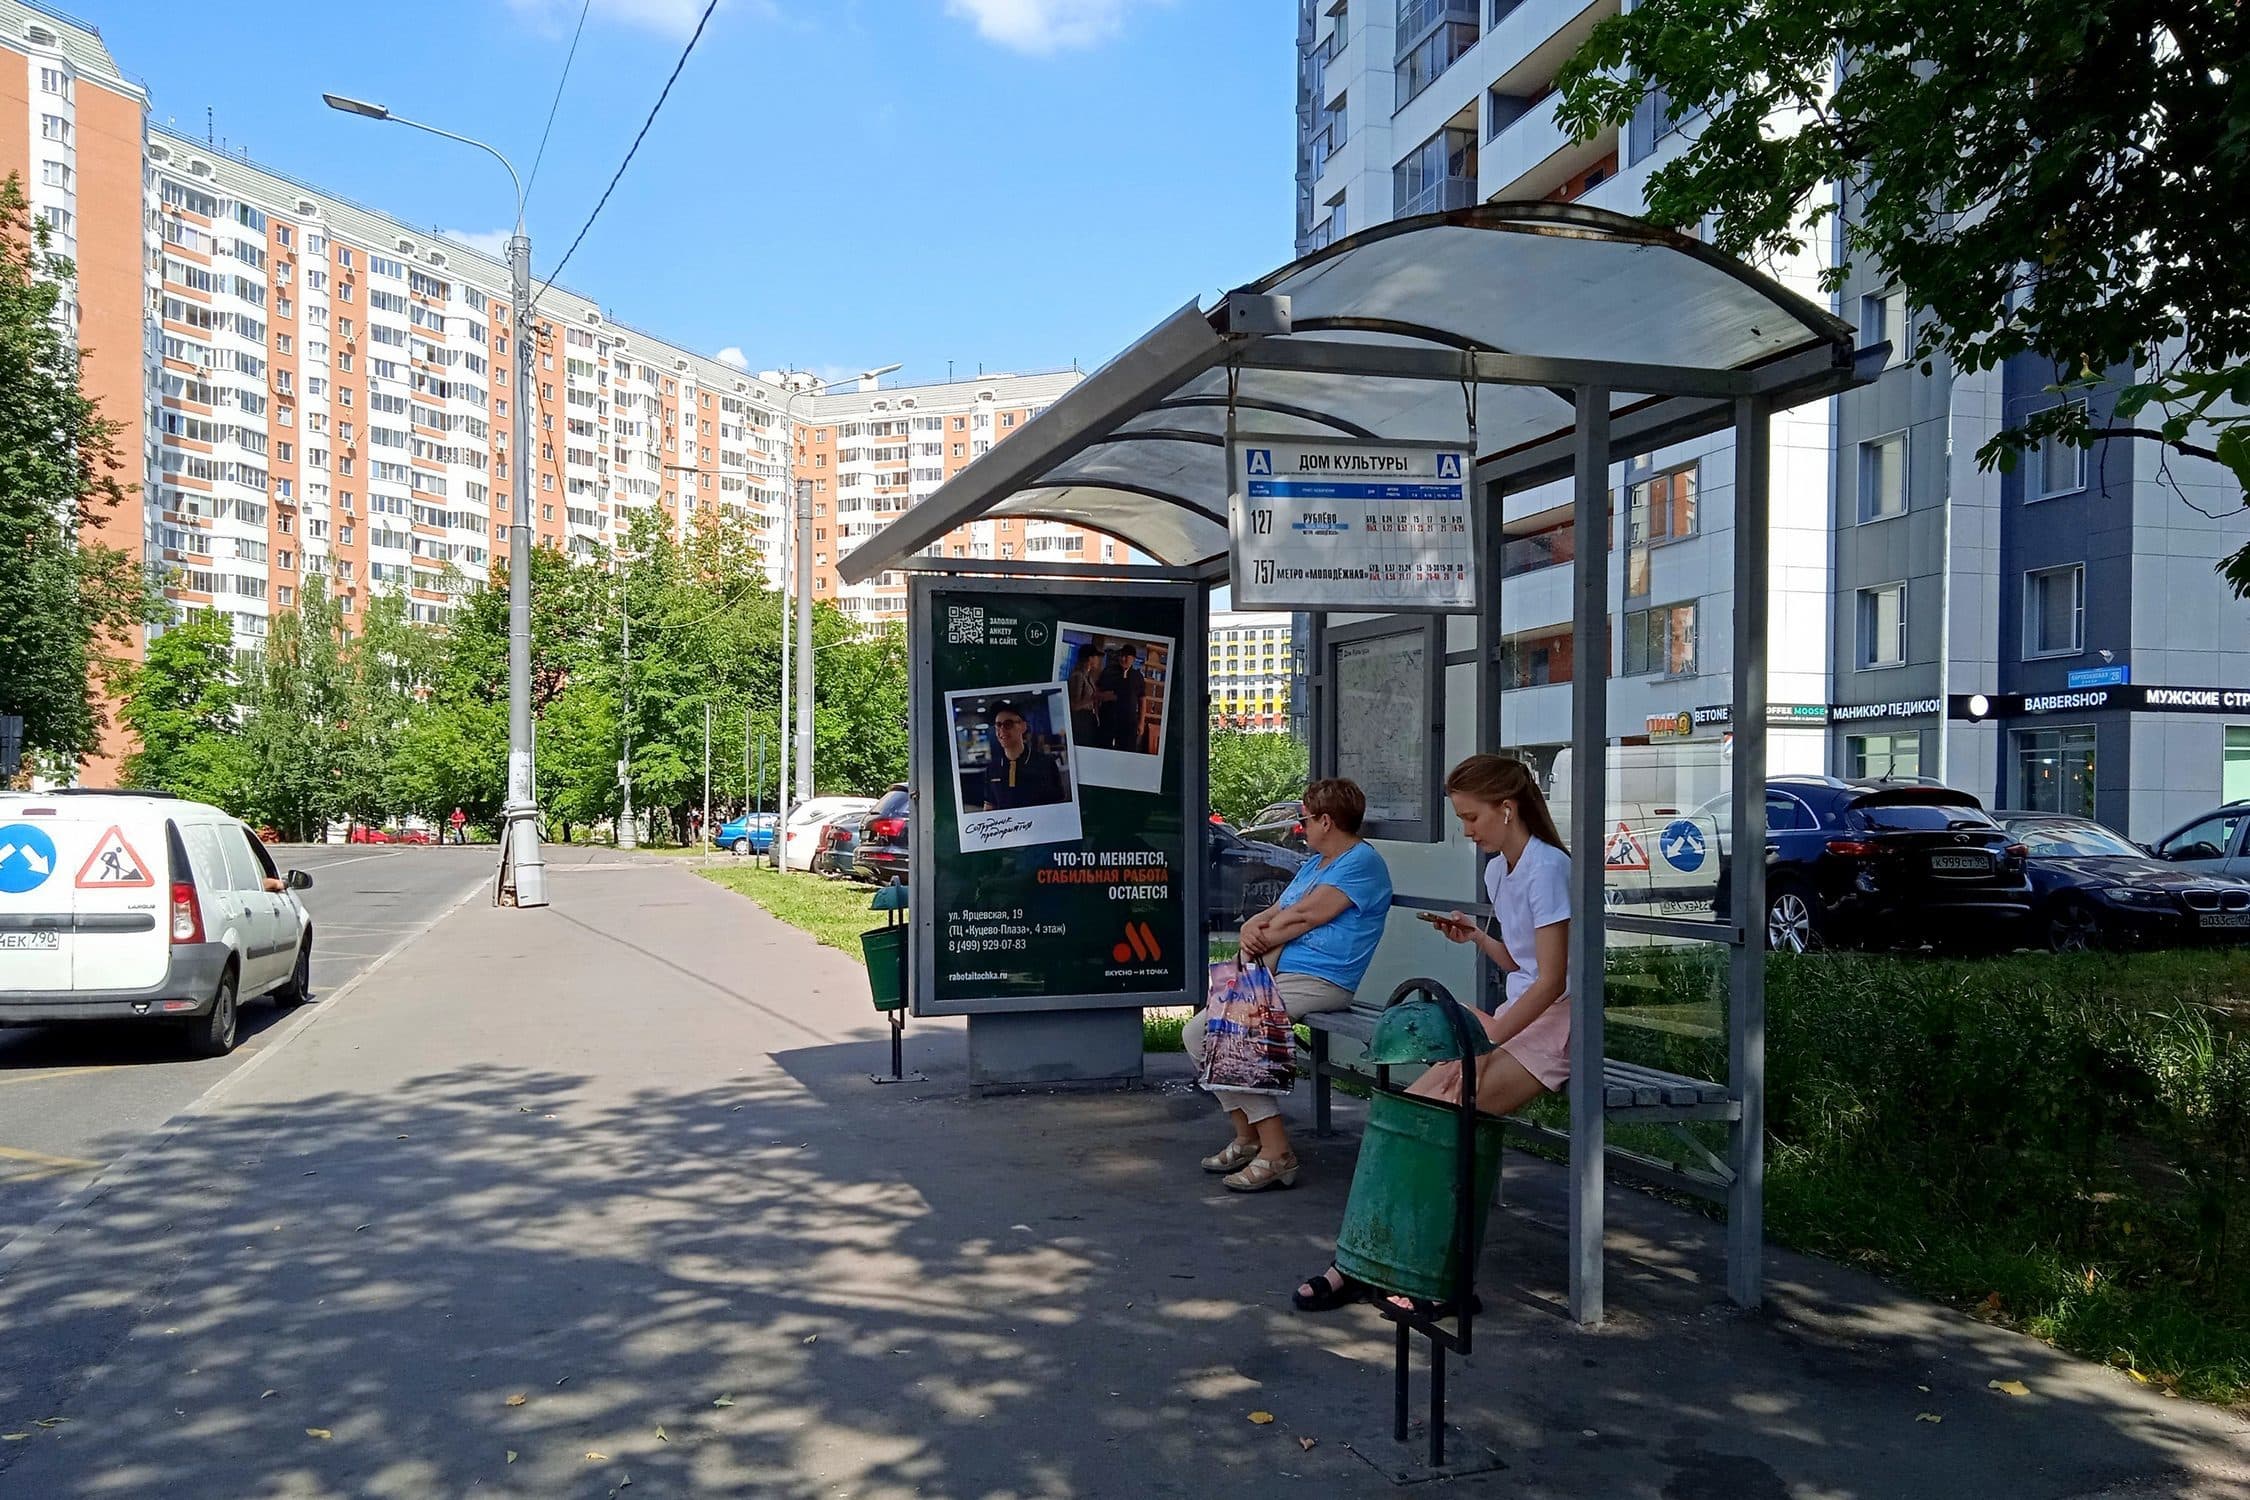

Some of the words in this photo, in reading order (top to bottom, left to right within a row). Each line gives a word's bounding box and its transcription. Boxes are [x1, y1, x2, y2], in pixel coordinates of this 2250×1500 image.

[1299, 455, 1330, 471] ДОМ
[1334, 455, 1408, 470] КУЛЬТУРЫ
[1251, 509, 1273, 534] 127
[1253, 559, 1275, 585] 757
[1276, 568, 1304, 580] МЕТРО
[2024, 692, 2107, 711] BARBERSHOP
[2146, 689, 2219, 706] МУЖСКИЕ
[1766, 706, 1792, 715] OFFEE
[1794, 706, 1825, 715] MOOSE
[1833, 704, 1887, 720] МАНИКЮР
[1053, 852, 1096, 866] ЧТО-ТО
[1099, 851, 1168, 868] МЕНЯЕТСЯ,
[1037, 868, 1119, 884] СТАБИЛЬНАЯ
[1123, 868, 1168, 882] РАБОТА
[1108, 885, 1168, 900] ОСТАЕТСЯ
[948, 912, 961, 922] ул.
[962, 909, 1010, 921] Ярцевская,
[1012, 908, 1023, 919] 19
[948, 925, 963, 937] (ТЦ
[1034, 923, 1040, 934] 4
[1042, 923, 1066, 935] этаж)
[948, 940, 955, 951] 8
[957, 940, 980, 953] (499)
[982, 938, 1026, 951] 929-07-83
[1104, 969, 1133, 977] ВКУСНО
[1145, 968, 1169, 976] ТОЧКА
